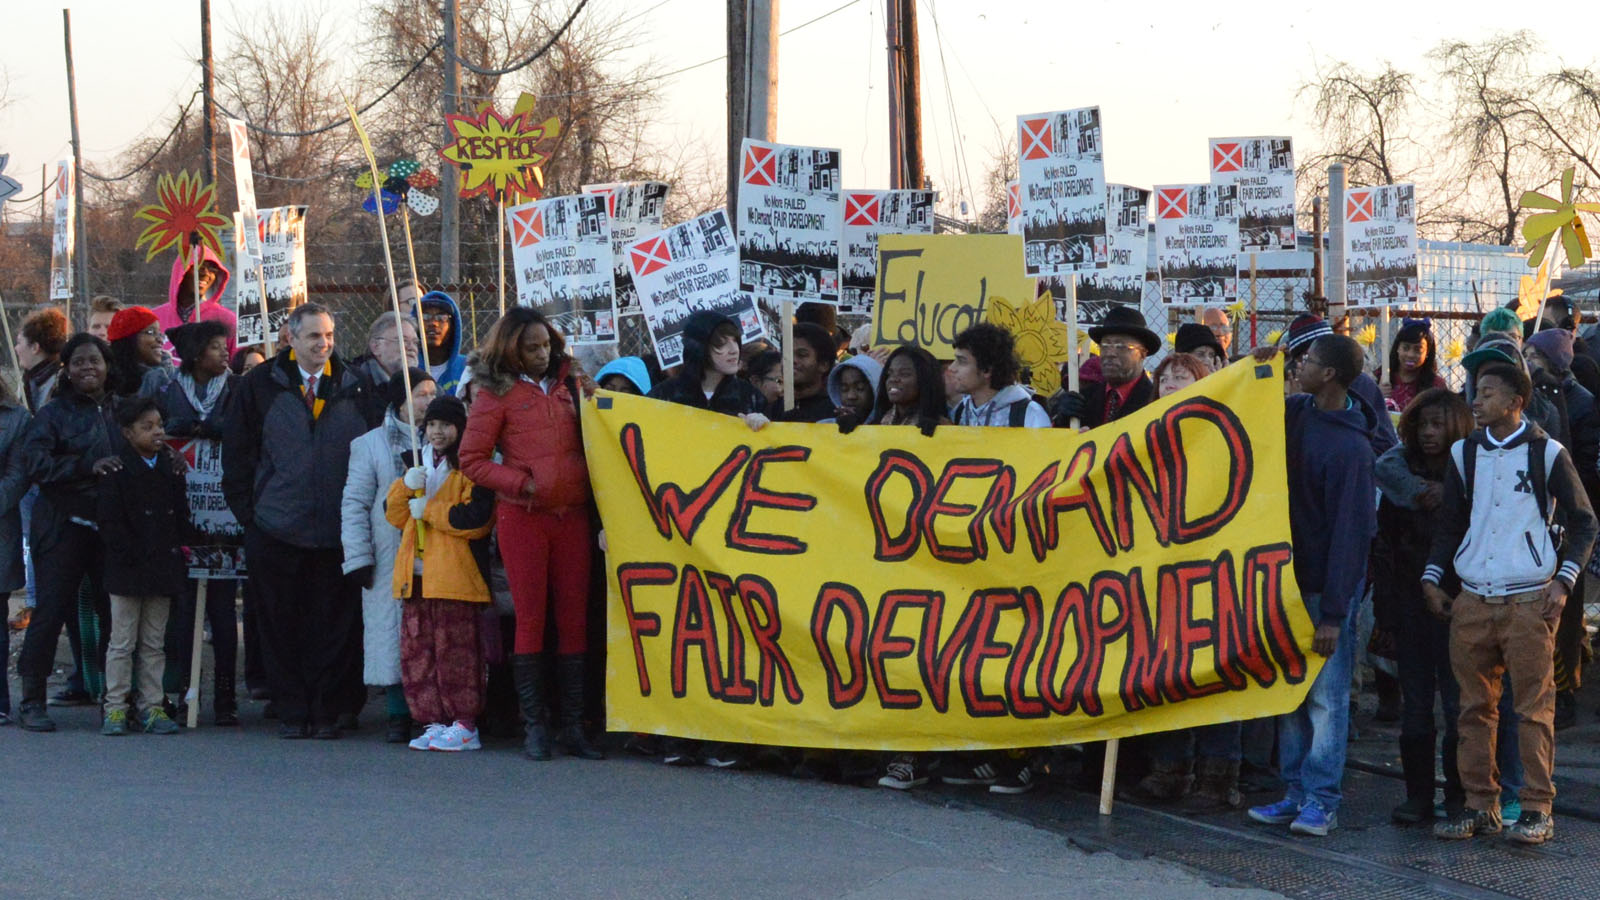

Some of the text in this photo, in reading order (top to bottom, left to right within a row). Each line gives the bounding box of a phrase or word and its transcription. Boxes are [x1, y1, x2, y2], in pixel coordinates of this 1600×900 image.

[456, 136, 537, 160] RESPECT
[1044, 165, 1077, 180] No More FAILED
[1250, 176, 1268, 185] FAILED
[1028, 178, 1094, 201] We Demand FAIR DEVELOPMENT
[1242, 188, 1254, 200] FAIR
[764, 195, 806, 210] No More FAILED
[748, 207, 825, 230] We Demand FAIR DEVELOPMENT
[611, 227, 636, 239] ore FAILED
[1195, 224, 1213, 234] FAILED
[866, 232, 872, 242] No
[1187, 236, 1198, 248] FAIR
[536, 246, 576, 263] No More FAILED
[612, 240, 622, 255] AIR
[849, 244, 855, 257] We
[272, 252, 286, 264] FAILED
[546, 260, 560, 279] FAIR
[664, 263, 708, 286] No More FAILED
[650, 268, 730, 307] We Demand FAIR DEVELOPMENT
[204, 481, 223, 493] FAILE
[619, 395, 1255, 565] WE DEMAND
[192, 495, 206, 510] FAIR
[617, 542, 1308, 718] FAIR DEVELOPMENT
